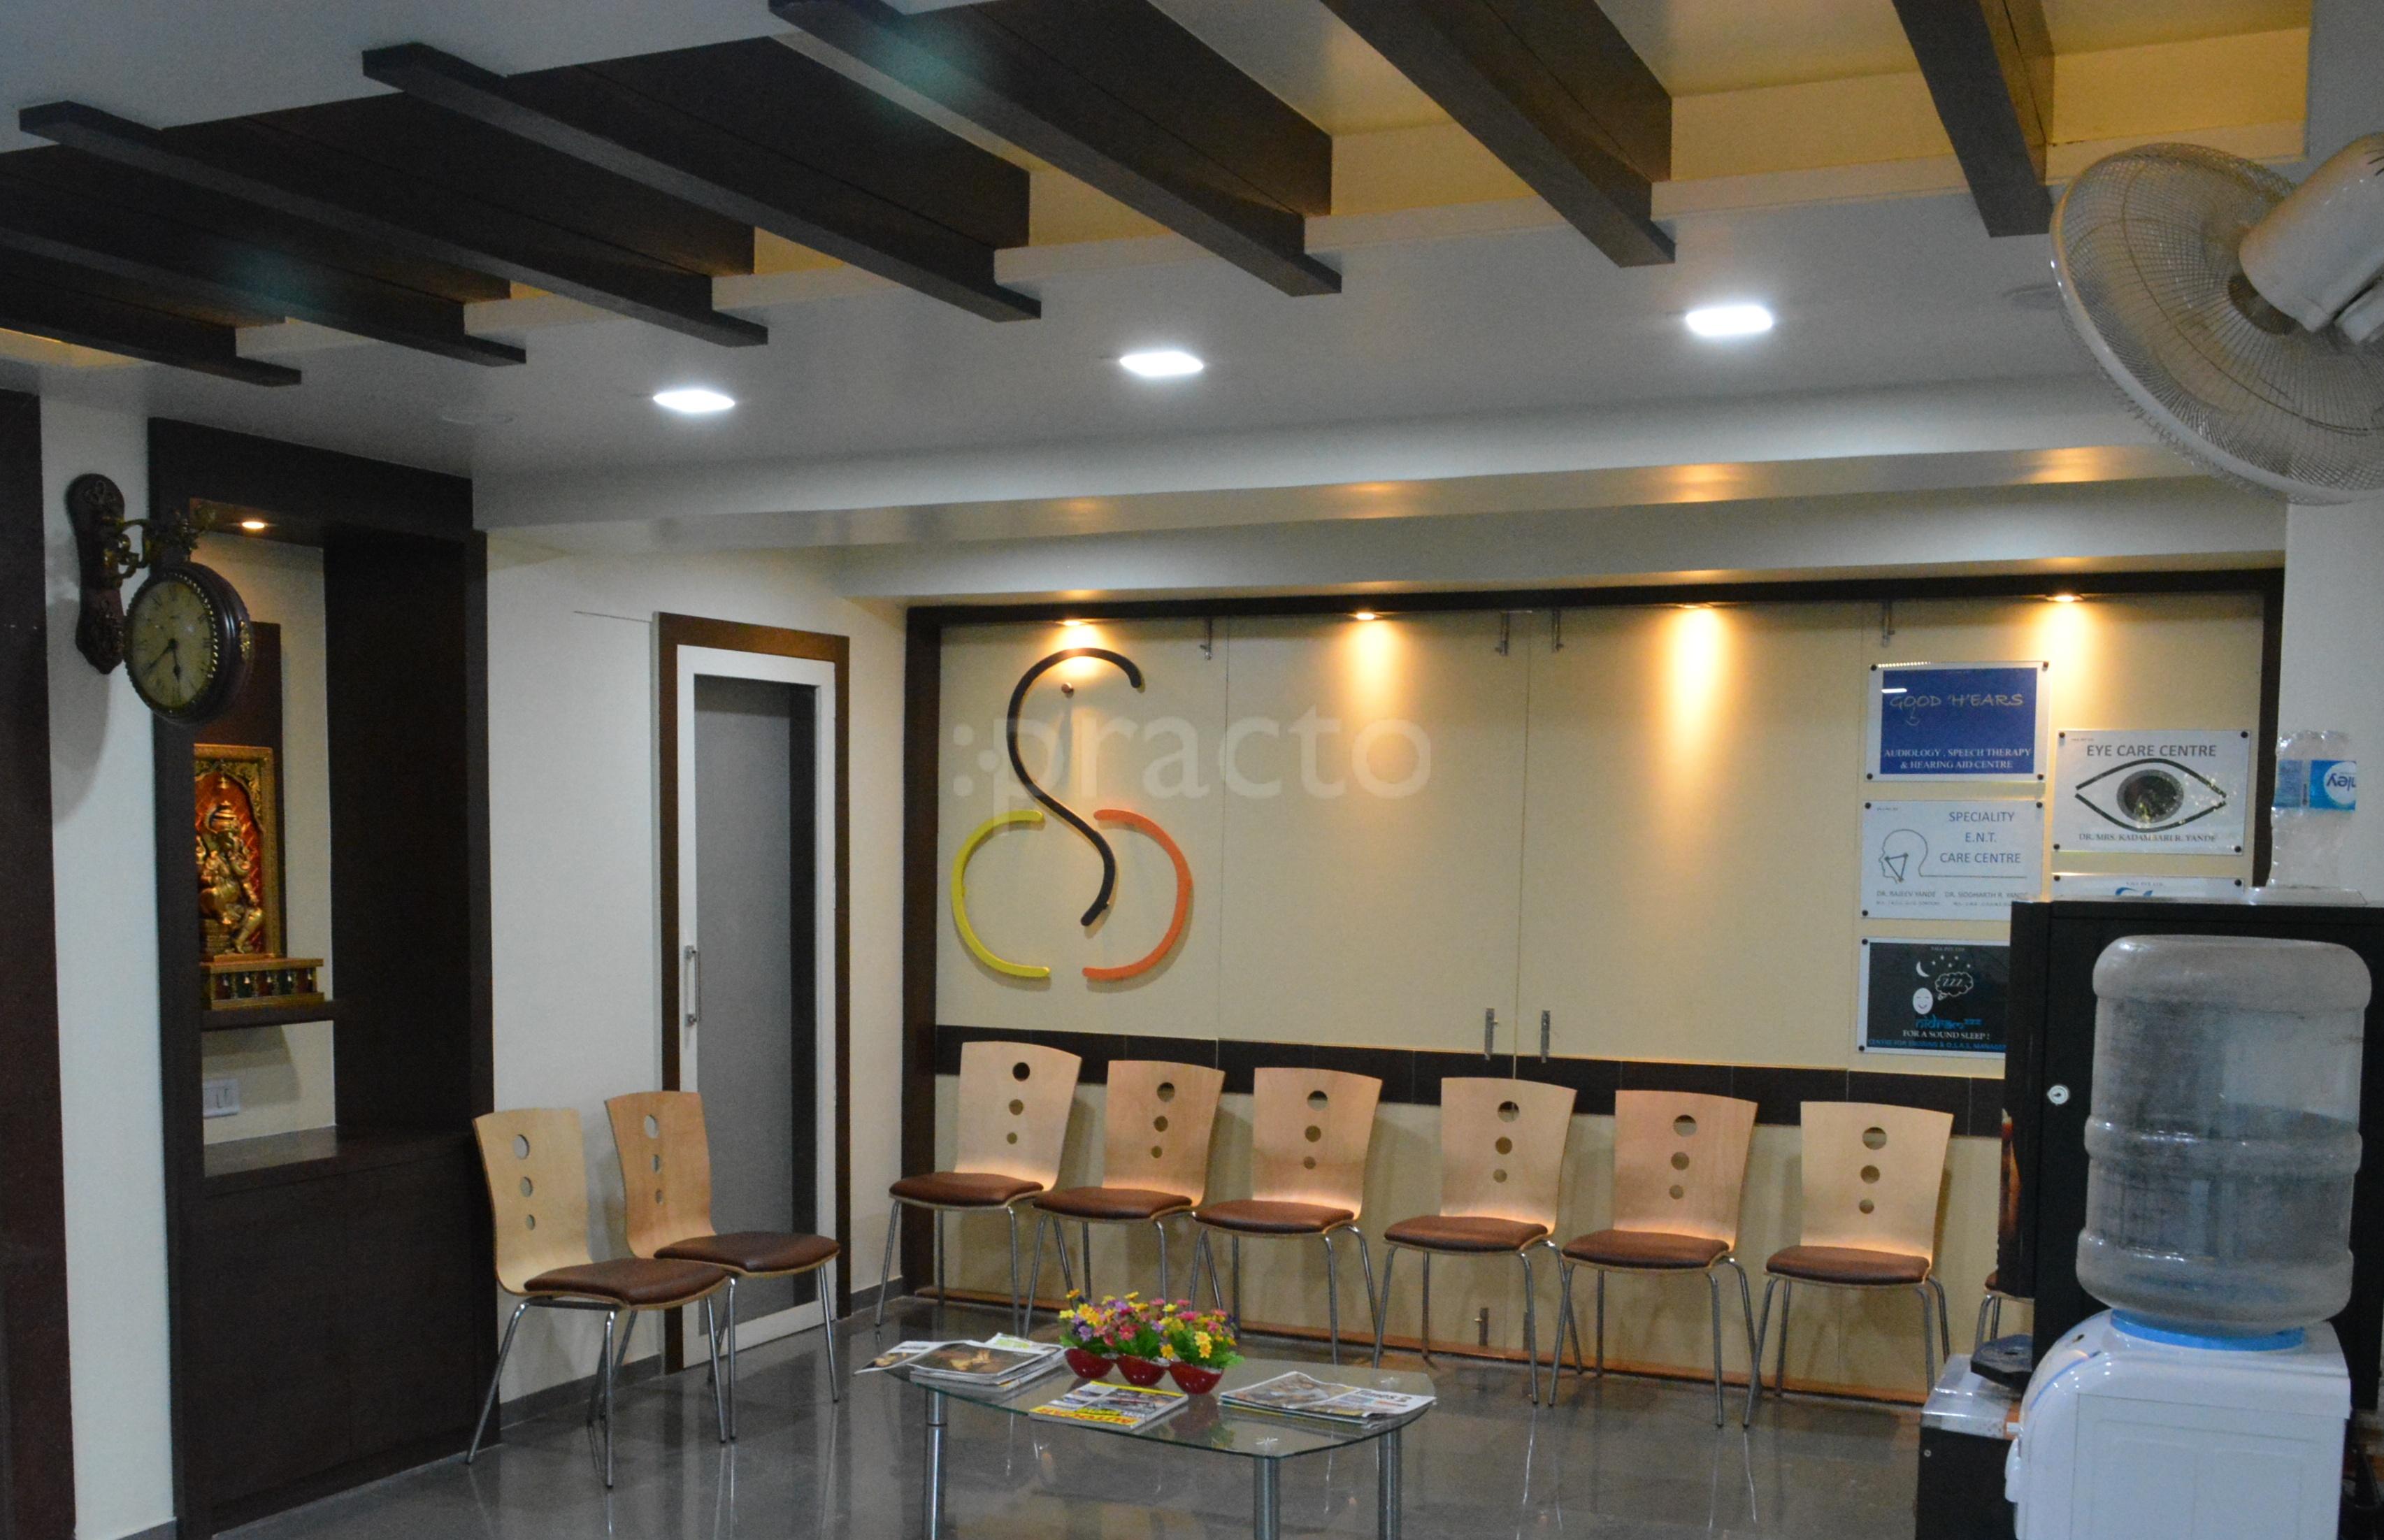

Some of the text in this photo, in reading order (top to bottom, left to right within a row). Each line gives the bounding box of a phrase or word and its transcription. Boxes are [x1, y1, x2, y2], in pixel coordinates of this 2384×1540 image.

[1890, 694, 1942, 710] GOOD
[1884, 749, 1941, 758] AUDIOLOGY
[1948, 749, 1984, 757] SPEECH
[1986, 748, 2032, 757] THERAPY
[2086, 744, 2218, 758] EYE CARE CENTRE
[1900, 761, 2013, 770] & HEARING AID CENTRE
[1948, 811, 2015, 823] SPECIALITY
[1965, 832, 1997, 843] E.N.T.
[1939, 852, 2022, 864] CARE CENTRE
[1929, 1030, 1960, 1039] SOUND
[1961, 1032, 1986, 1040] SLEEP
